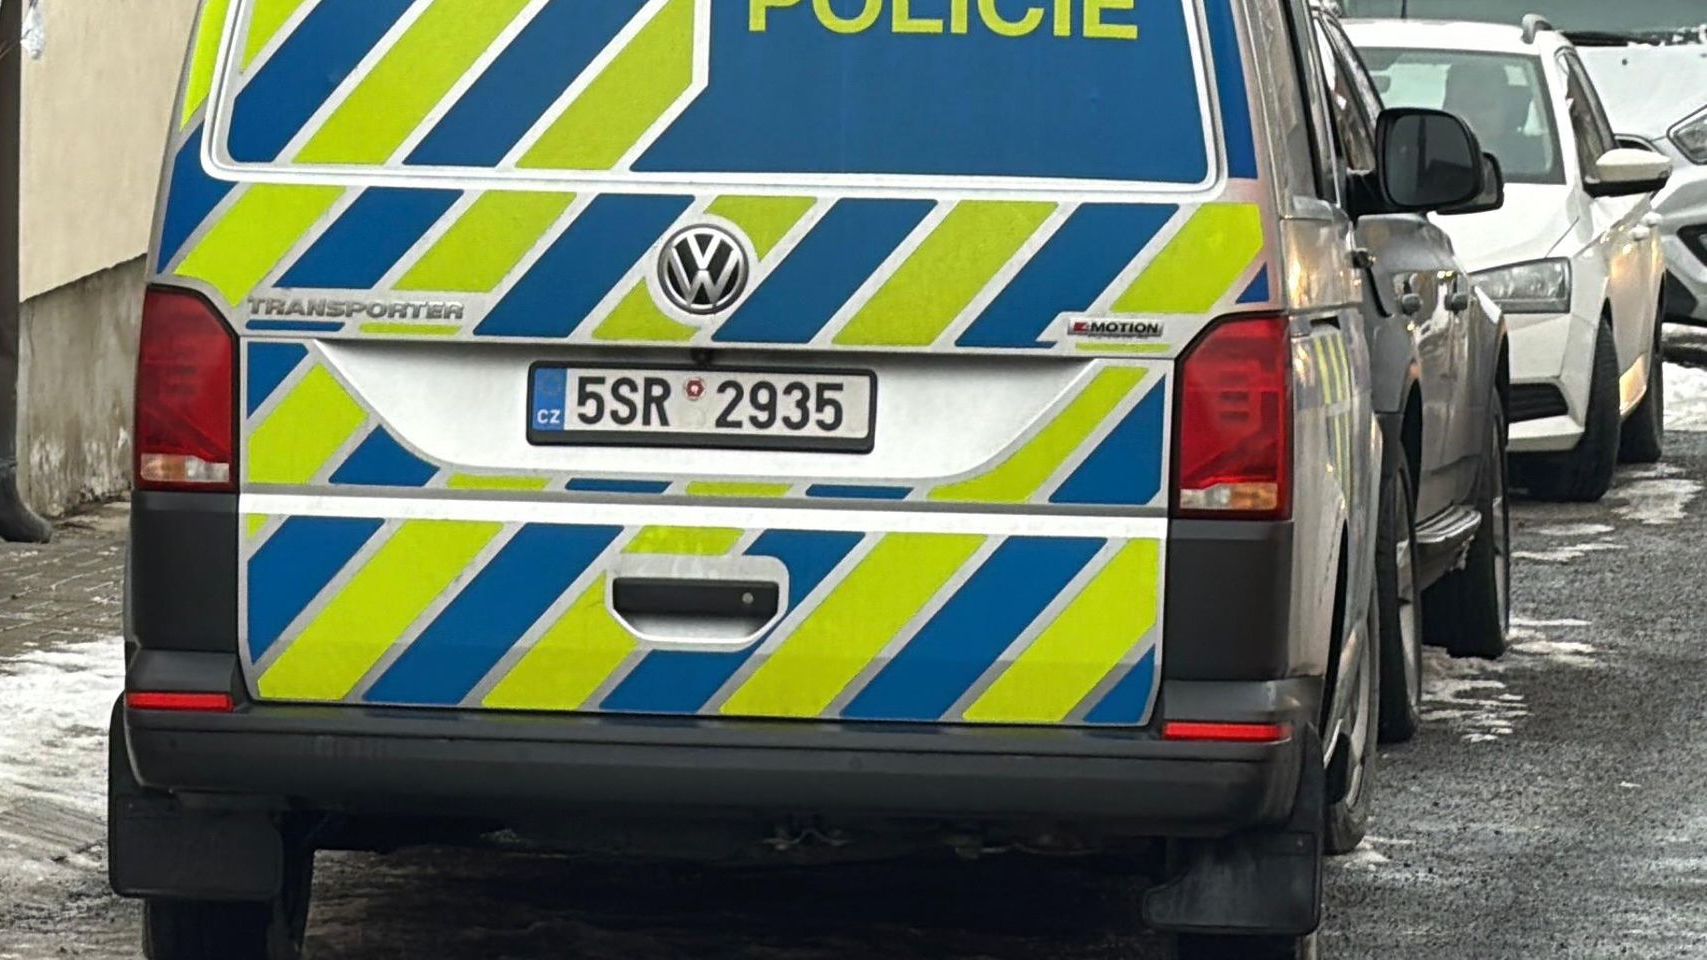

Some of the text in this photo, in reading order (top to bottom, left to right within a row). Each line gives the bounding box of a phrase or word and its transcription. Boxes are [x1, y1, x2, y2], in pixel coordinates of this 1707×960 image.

[246, 296, 465, 320] TRANSPORTER
[576, 375, 845, 432] 5SR 2935
[536, 408, 561, 425] CZ
